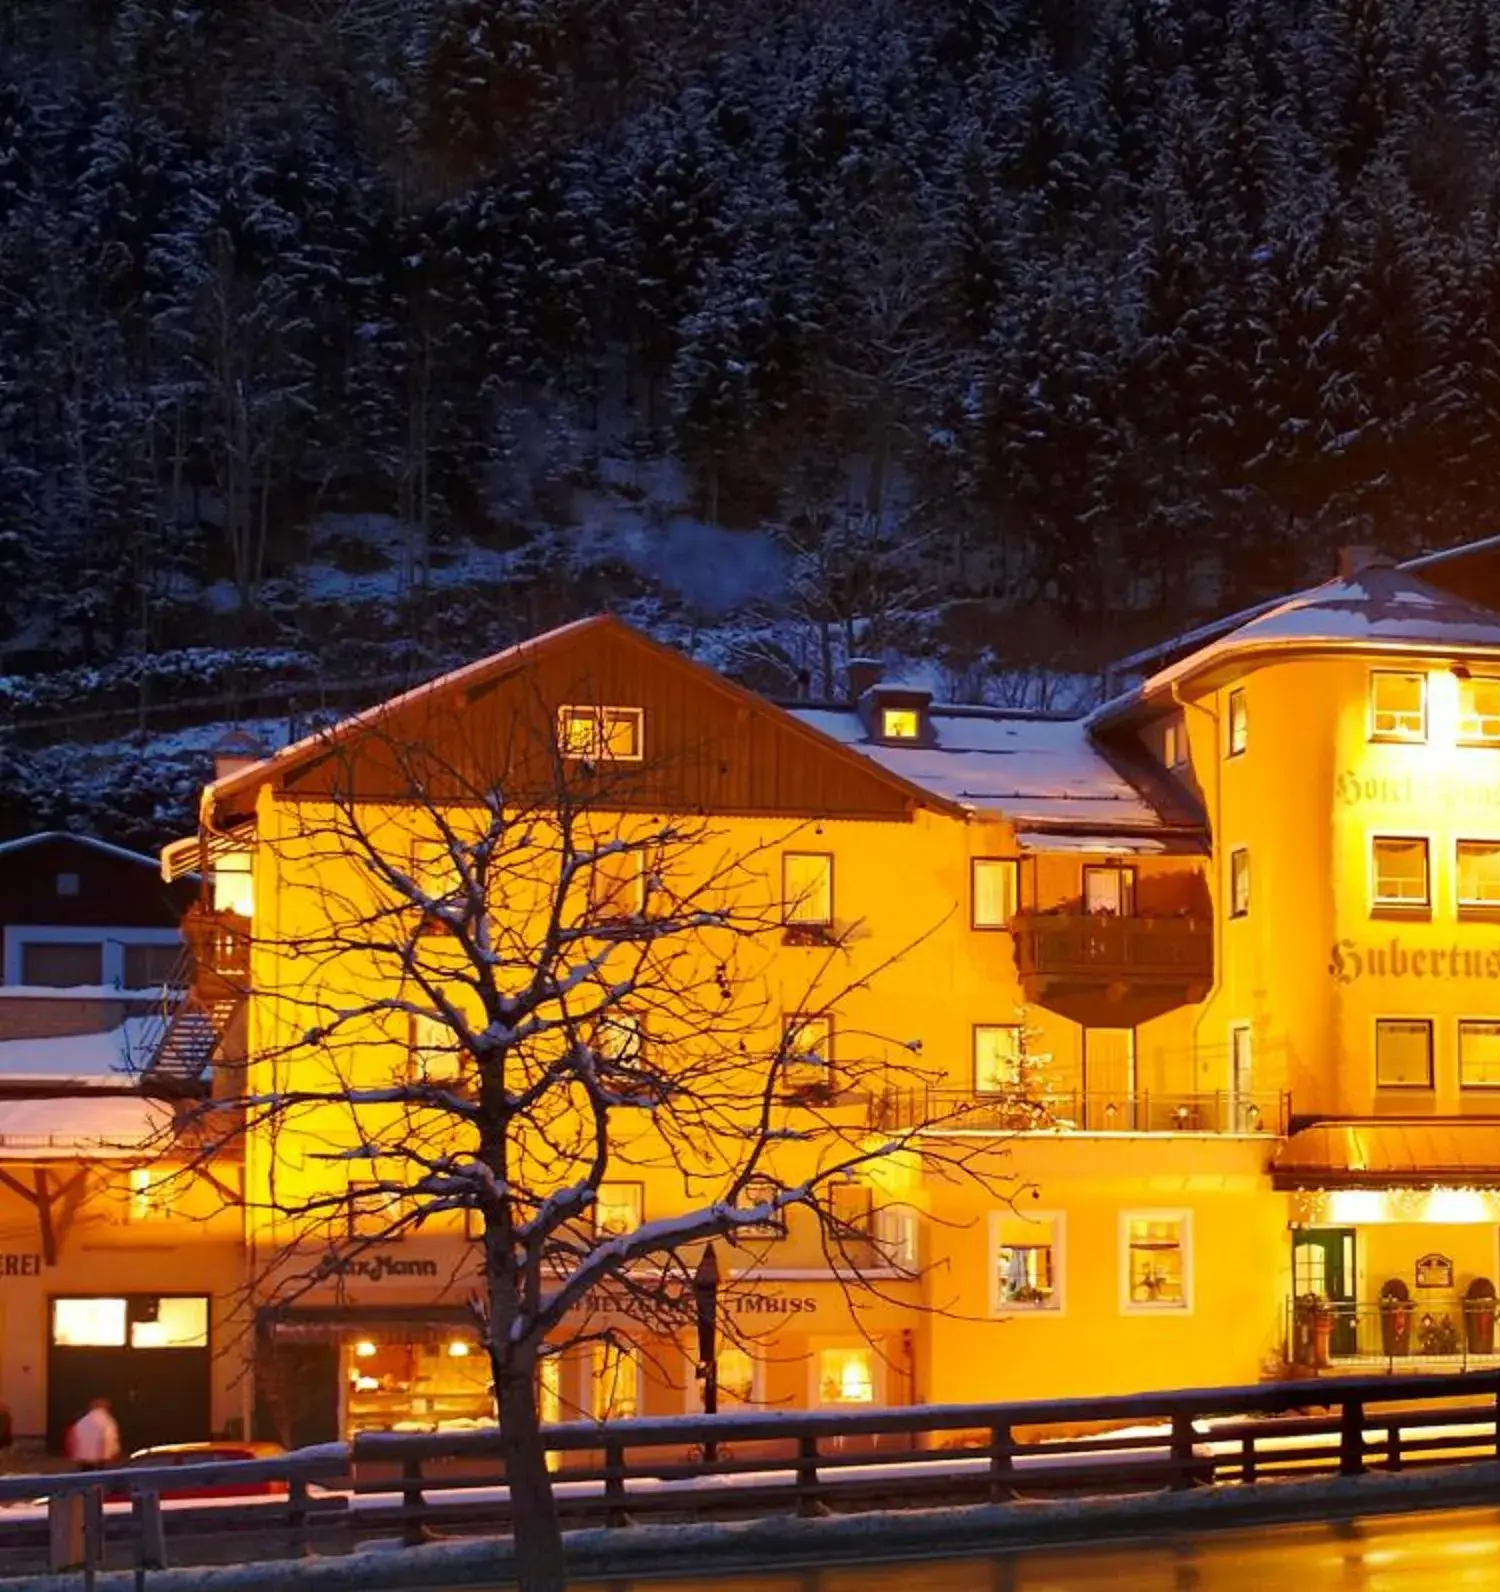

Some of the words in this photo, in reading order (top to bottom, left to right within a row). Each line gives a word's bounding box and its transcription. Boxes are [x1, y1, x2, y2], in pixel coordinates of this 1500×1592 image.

[1336, 768, 1413, 806] Hotel
[0, 1253, 40, 1276] REI
[368, 1255, 437, 1281] Mann
[735, 1297, 817, 1314] IMBISS
